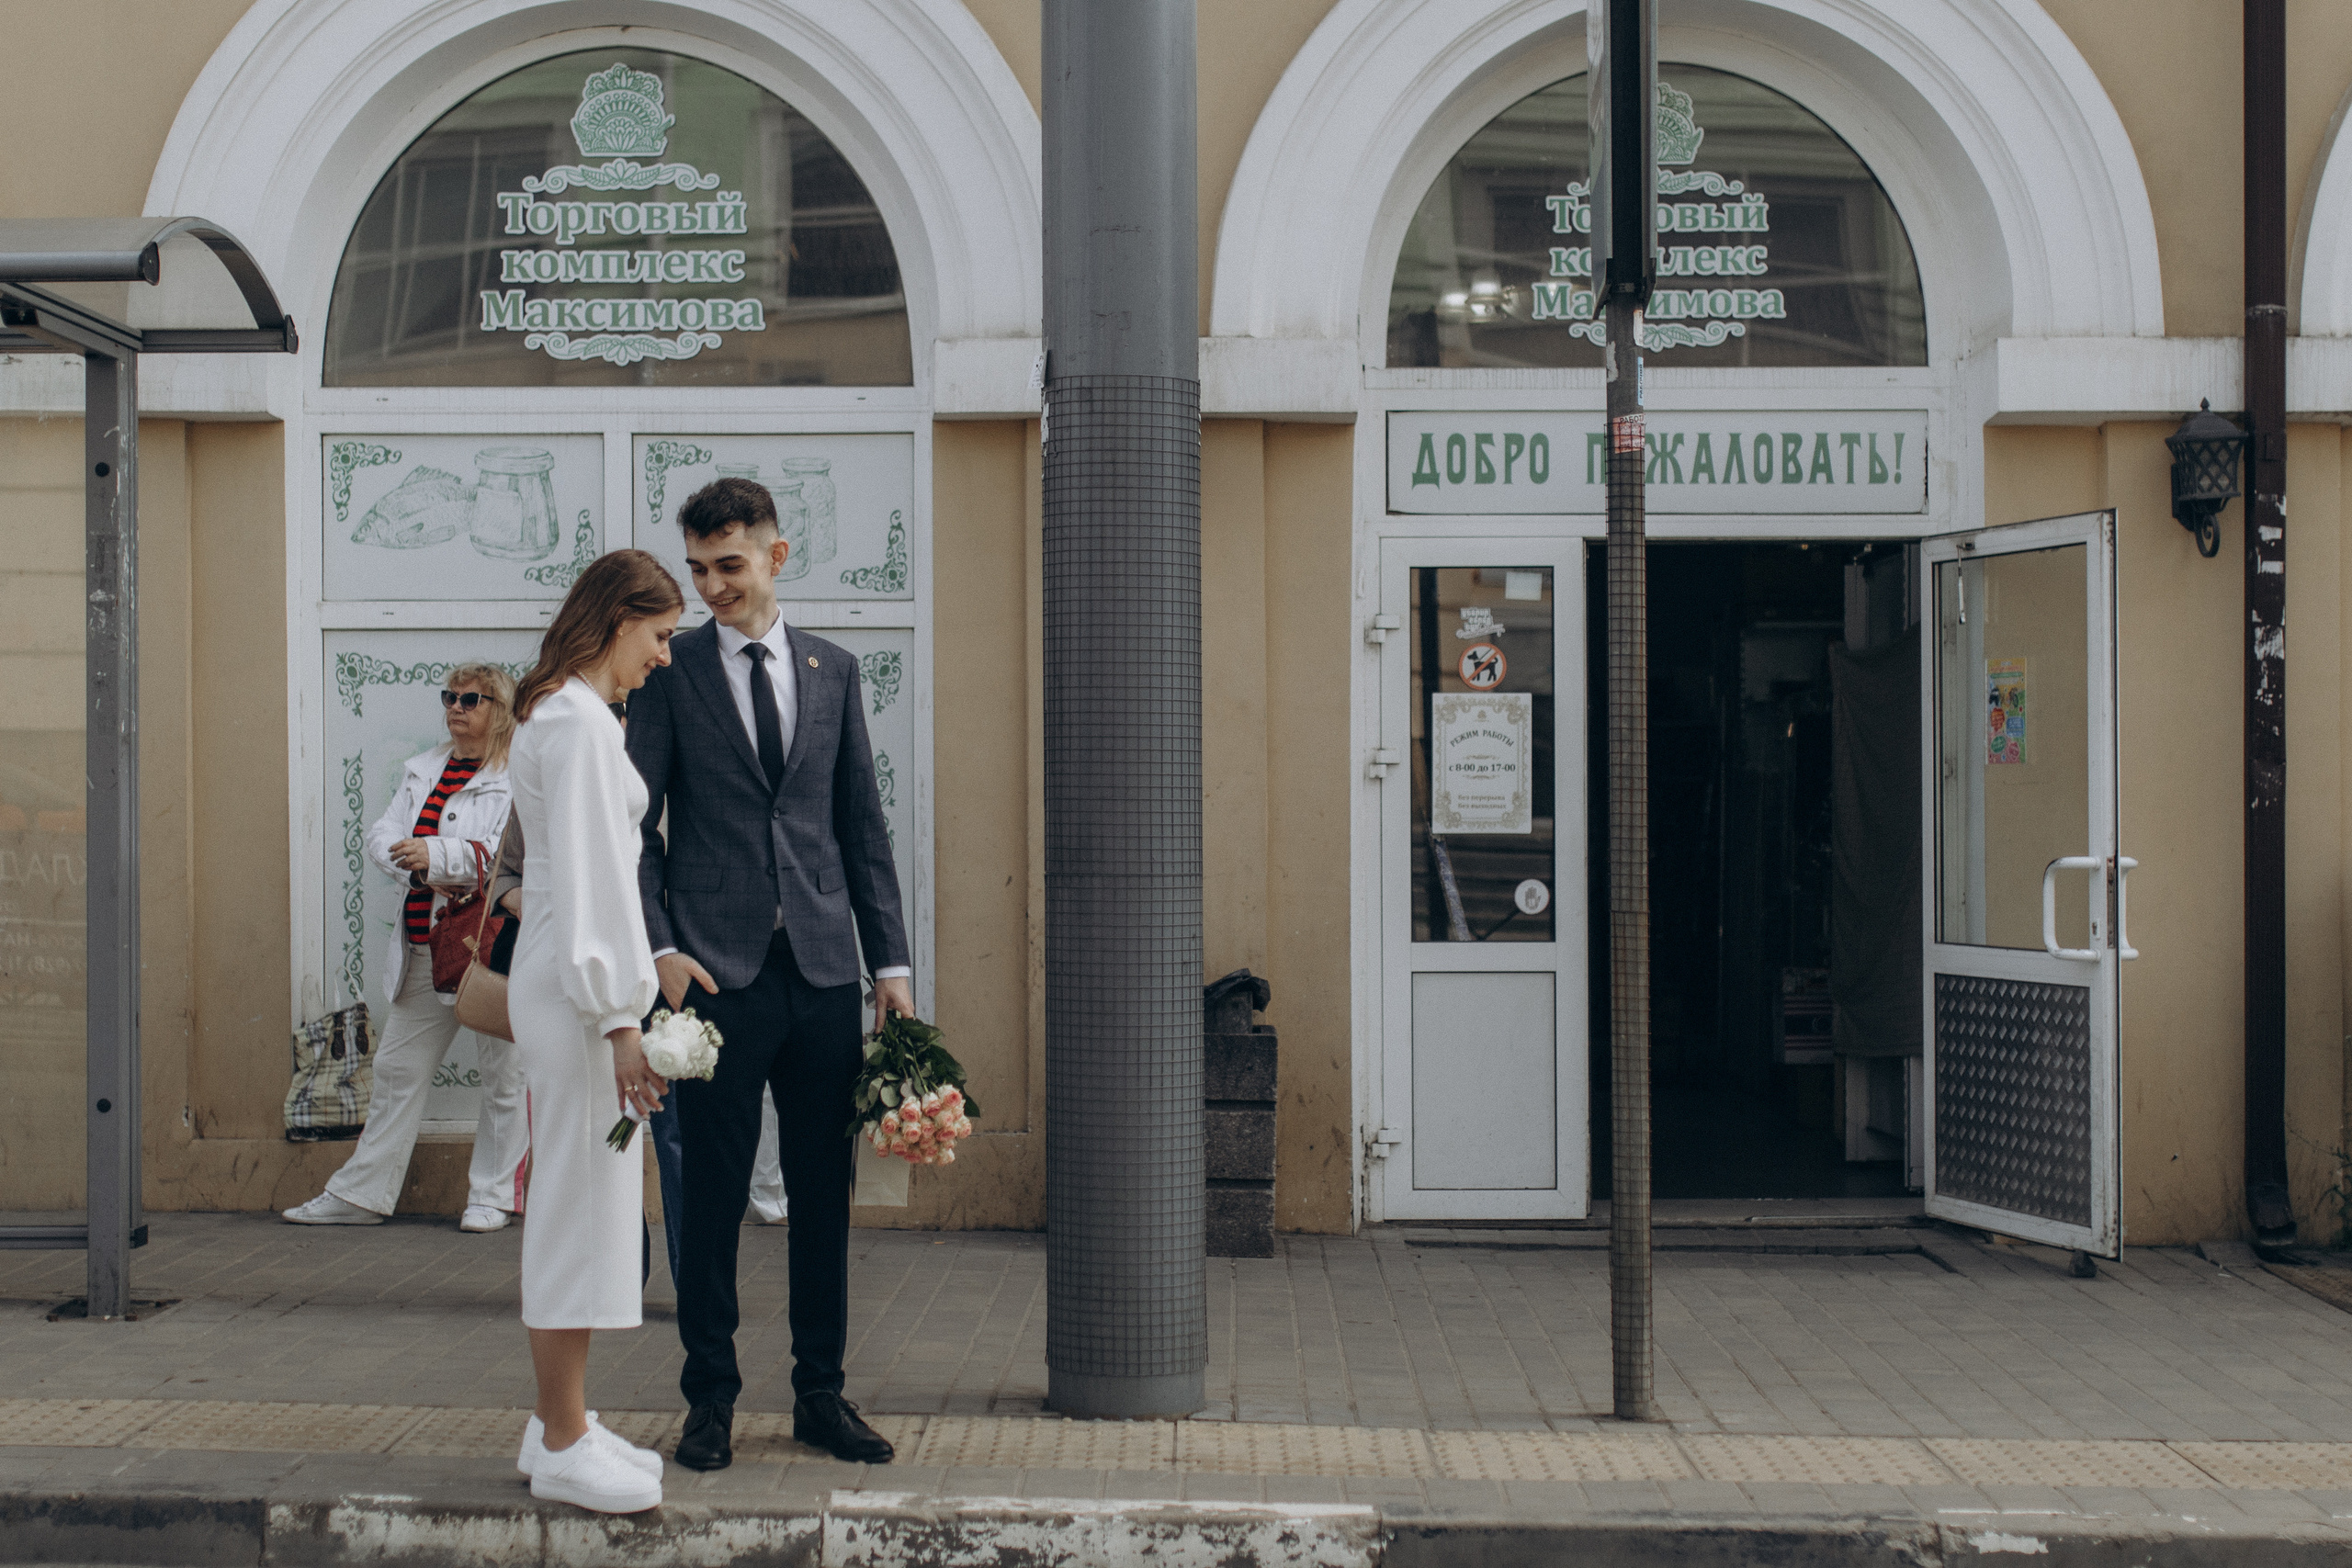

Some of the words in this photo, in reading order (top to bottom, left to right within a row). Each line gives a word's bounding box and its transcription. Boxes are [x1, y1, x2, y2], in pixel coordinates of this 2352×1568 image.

[499, 193, 746, 243] Торговый
[1548, 195, 1768, 231] Тоовый
[503, 252, 745, 281] комплекс
[1553, 247, 1767, 274] колекс
[481, 291, 764, 329] Максимова
[1533, 285, 1785, 318] Маимова
[1412, 433, 1550, 491] ДОБРО
[1586, 433, 1906, 485] ПЖАЛОВАТЬ!
[1451, 729, 1479, 748] РЕЖИМ
[1483, 729, 1515, 748] РАБОТЫ
[1455, 763, 1476, 772] 8-00
[1491, 763, 1516, 772] 17-00
